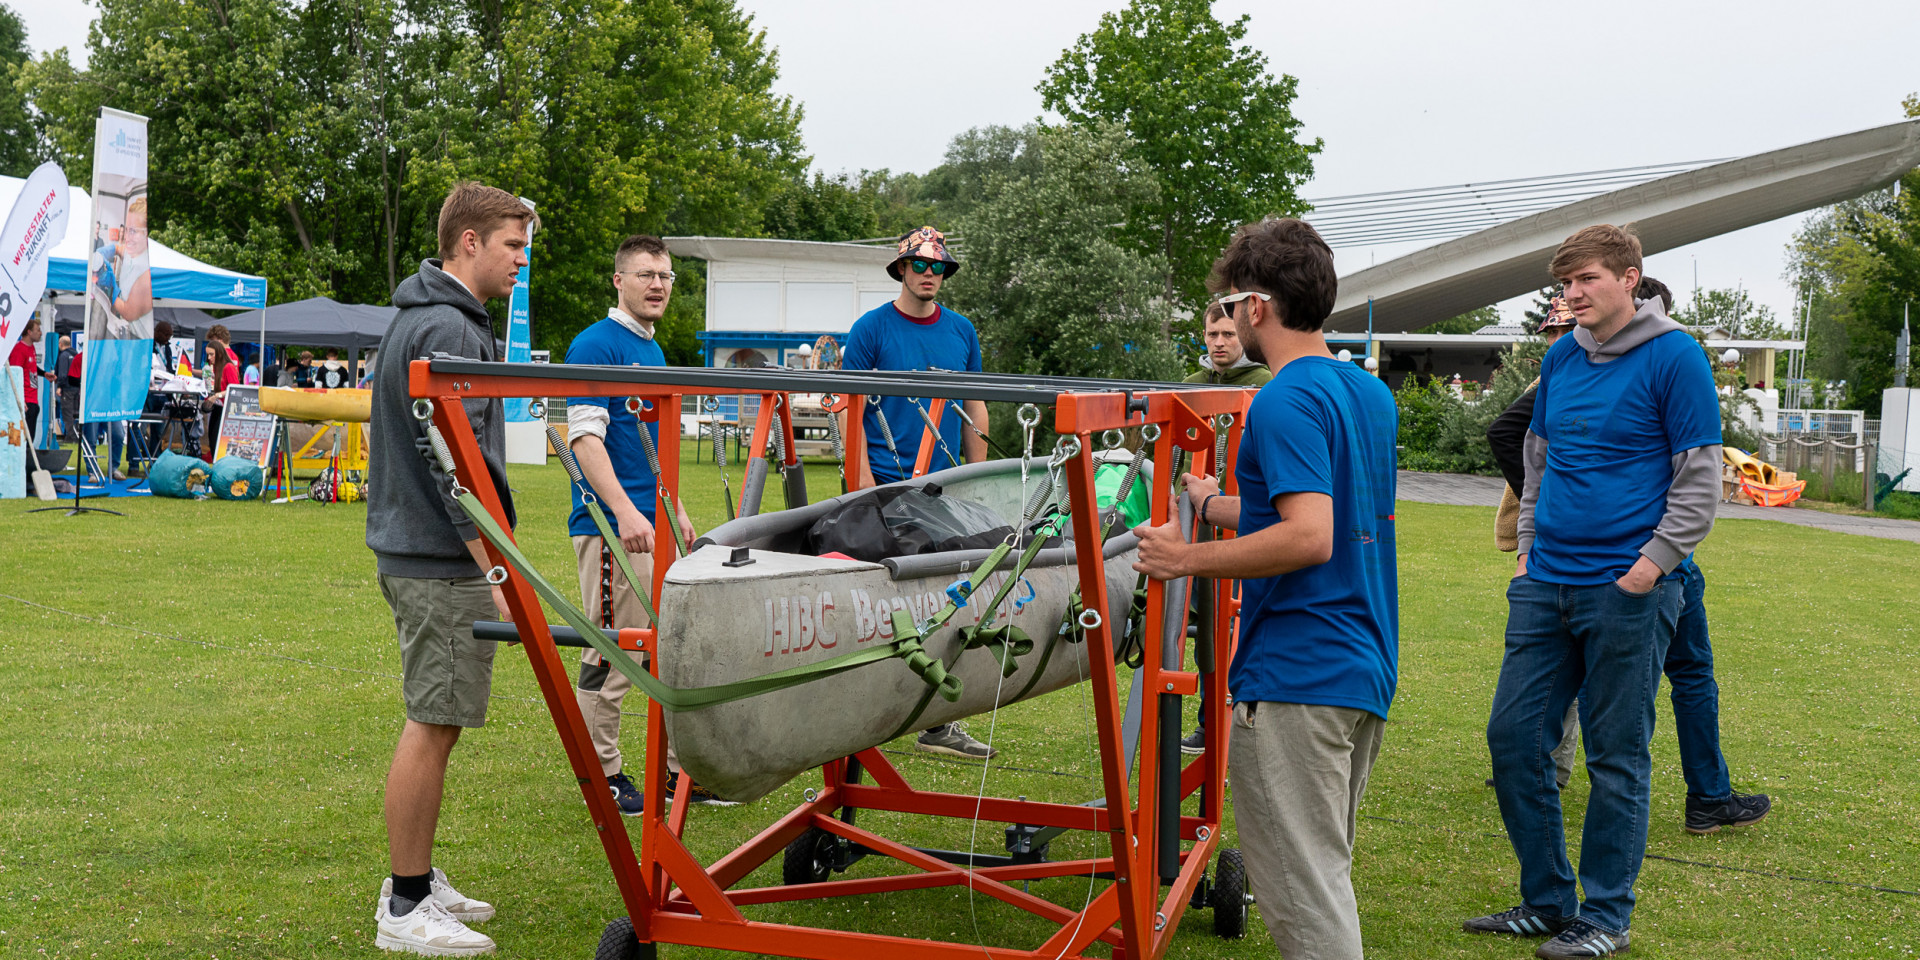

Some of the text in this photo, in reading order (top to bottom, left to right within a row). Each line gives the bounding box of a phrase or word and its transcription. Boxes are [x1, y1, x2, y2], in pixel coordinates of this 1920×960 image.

[12, 243, 27, 266] WIR
[23, 188, 57, 244] GESTALTEN
[25, 212, 51, 262] ZUKUNFT
[764, 590, 838, 657] HBC
